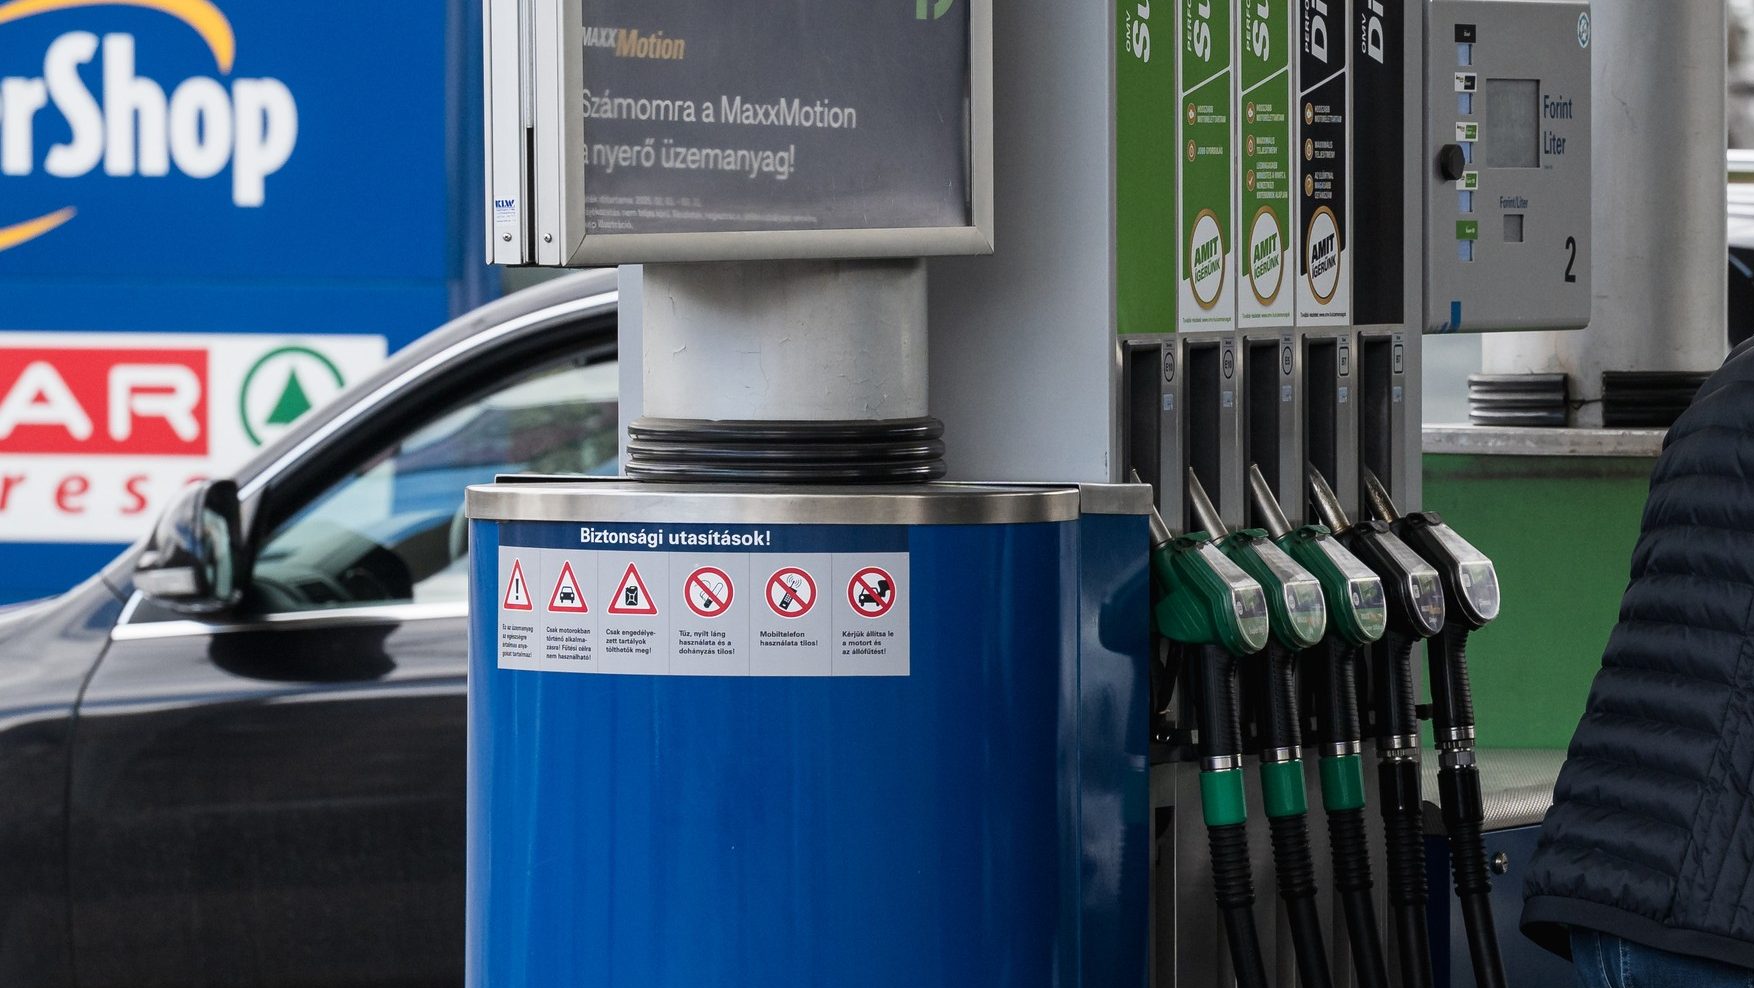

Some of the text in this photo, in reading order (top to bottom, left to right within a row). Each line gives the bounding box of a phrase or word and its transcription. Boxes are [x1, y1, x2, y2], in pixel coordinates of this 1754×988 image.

[1, 30, 298, 207] rShop
[582, 88, 857, 128] Számomra a MaxxMotion
[1543, 95, 1573, 119] Forint
[1544, 131, 1566, 155] Liter
[593, 138, 654, 174] nyerő
[661, 139, 795, 180] üzemanyag!
[1499, 196, 1528, 209] Forint/Liter
[1193, 235, 1219, 268] AMIT
[1253, 232, 1278, 264] AMIT
[1311, 232, 1335, 264] AMIT
[1565, 236, 1576, 283] 2
[0, 361, 201, 442] AR
[0, 473, 208, 513] res
[580, 527, 771, 547] Biztonsági utasítások!
[619, 638, 646, 646] tartályok
[710, 630, 726, 639] láng
[842, 630, 865, 639] Kérjük
[635, 647, 651, 655] meg!
[679, 648, 715, 656] dohányzás
